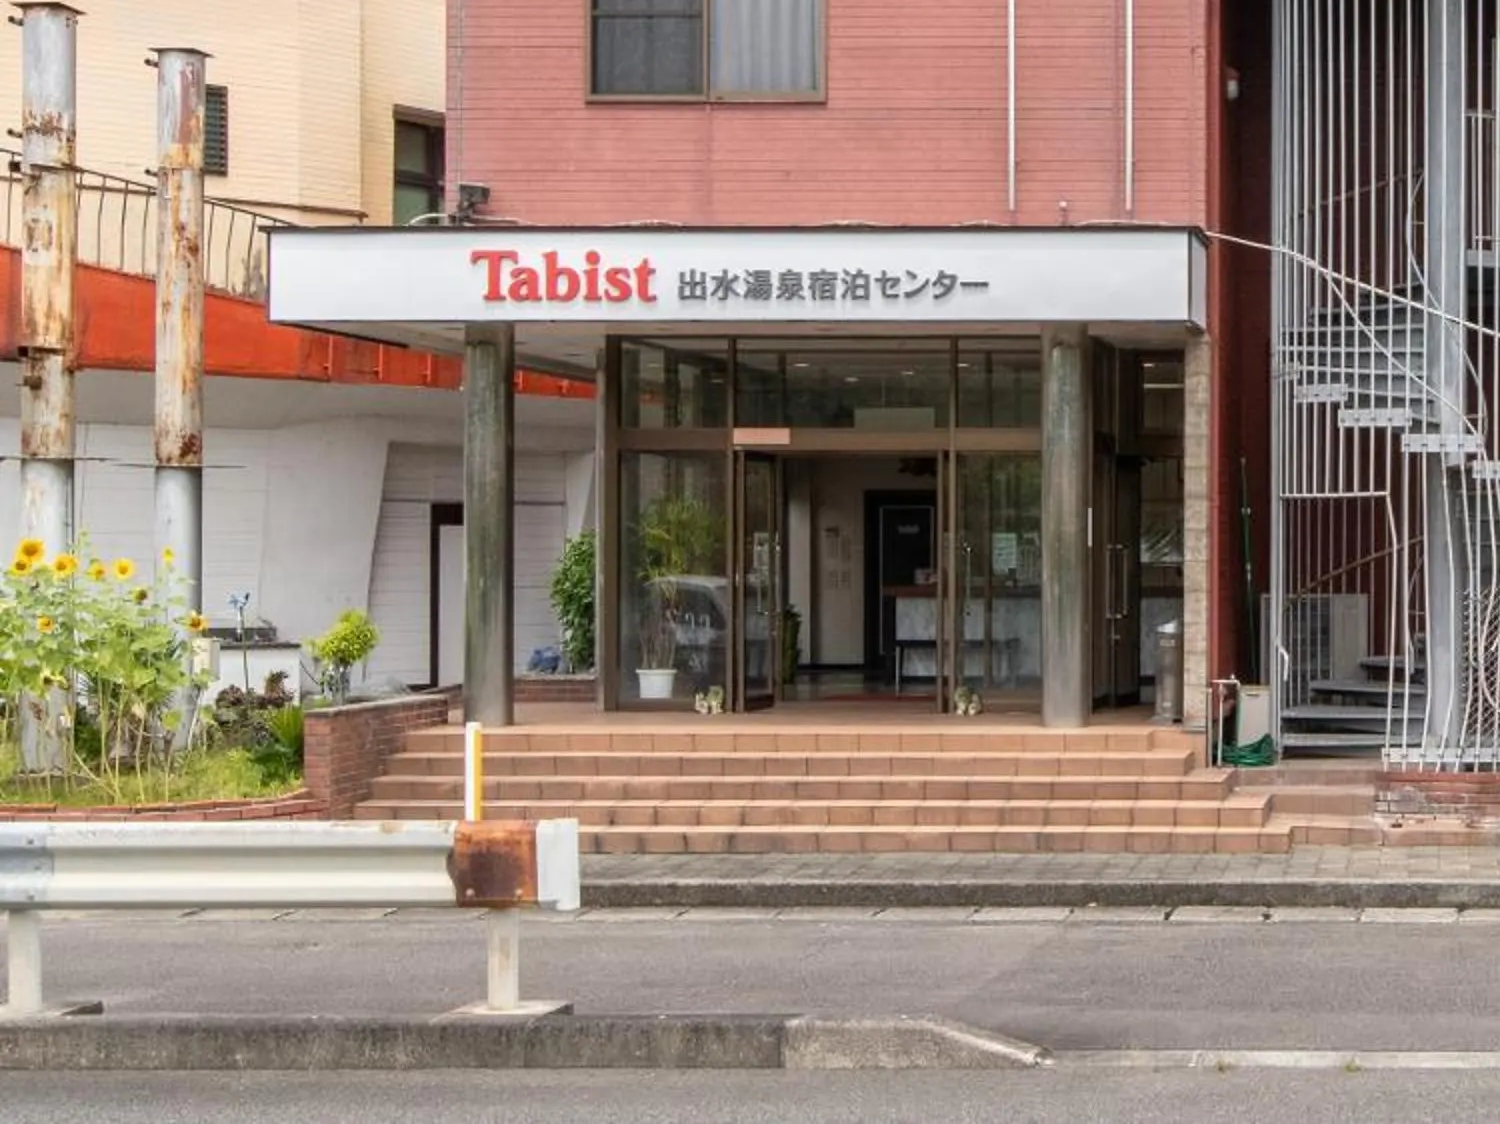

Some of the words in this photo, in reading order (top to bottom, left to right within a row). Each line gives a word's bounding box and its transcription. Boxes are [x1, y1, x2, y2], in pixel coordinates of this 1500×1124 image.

[470, 250, 657, 303] Tabist
[677, 268, 989, 301] 出水湯泉宿泊センター
